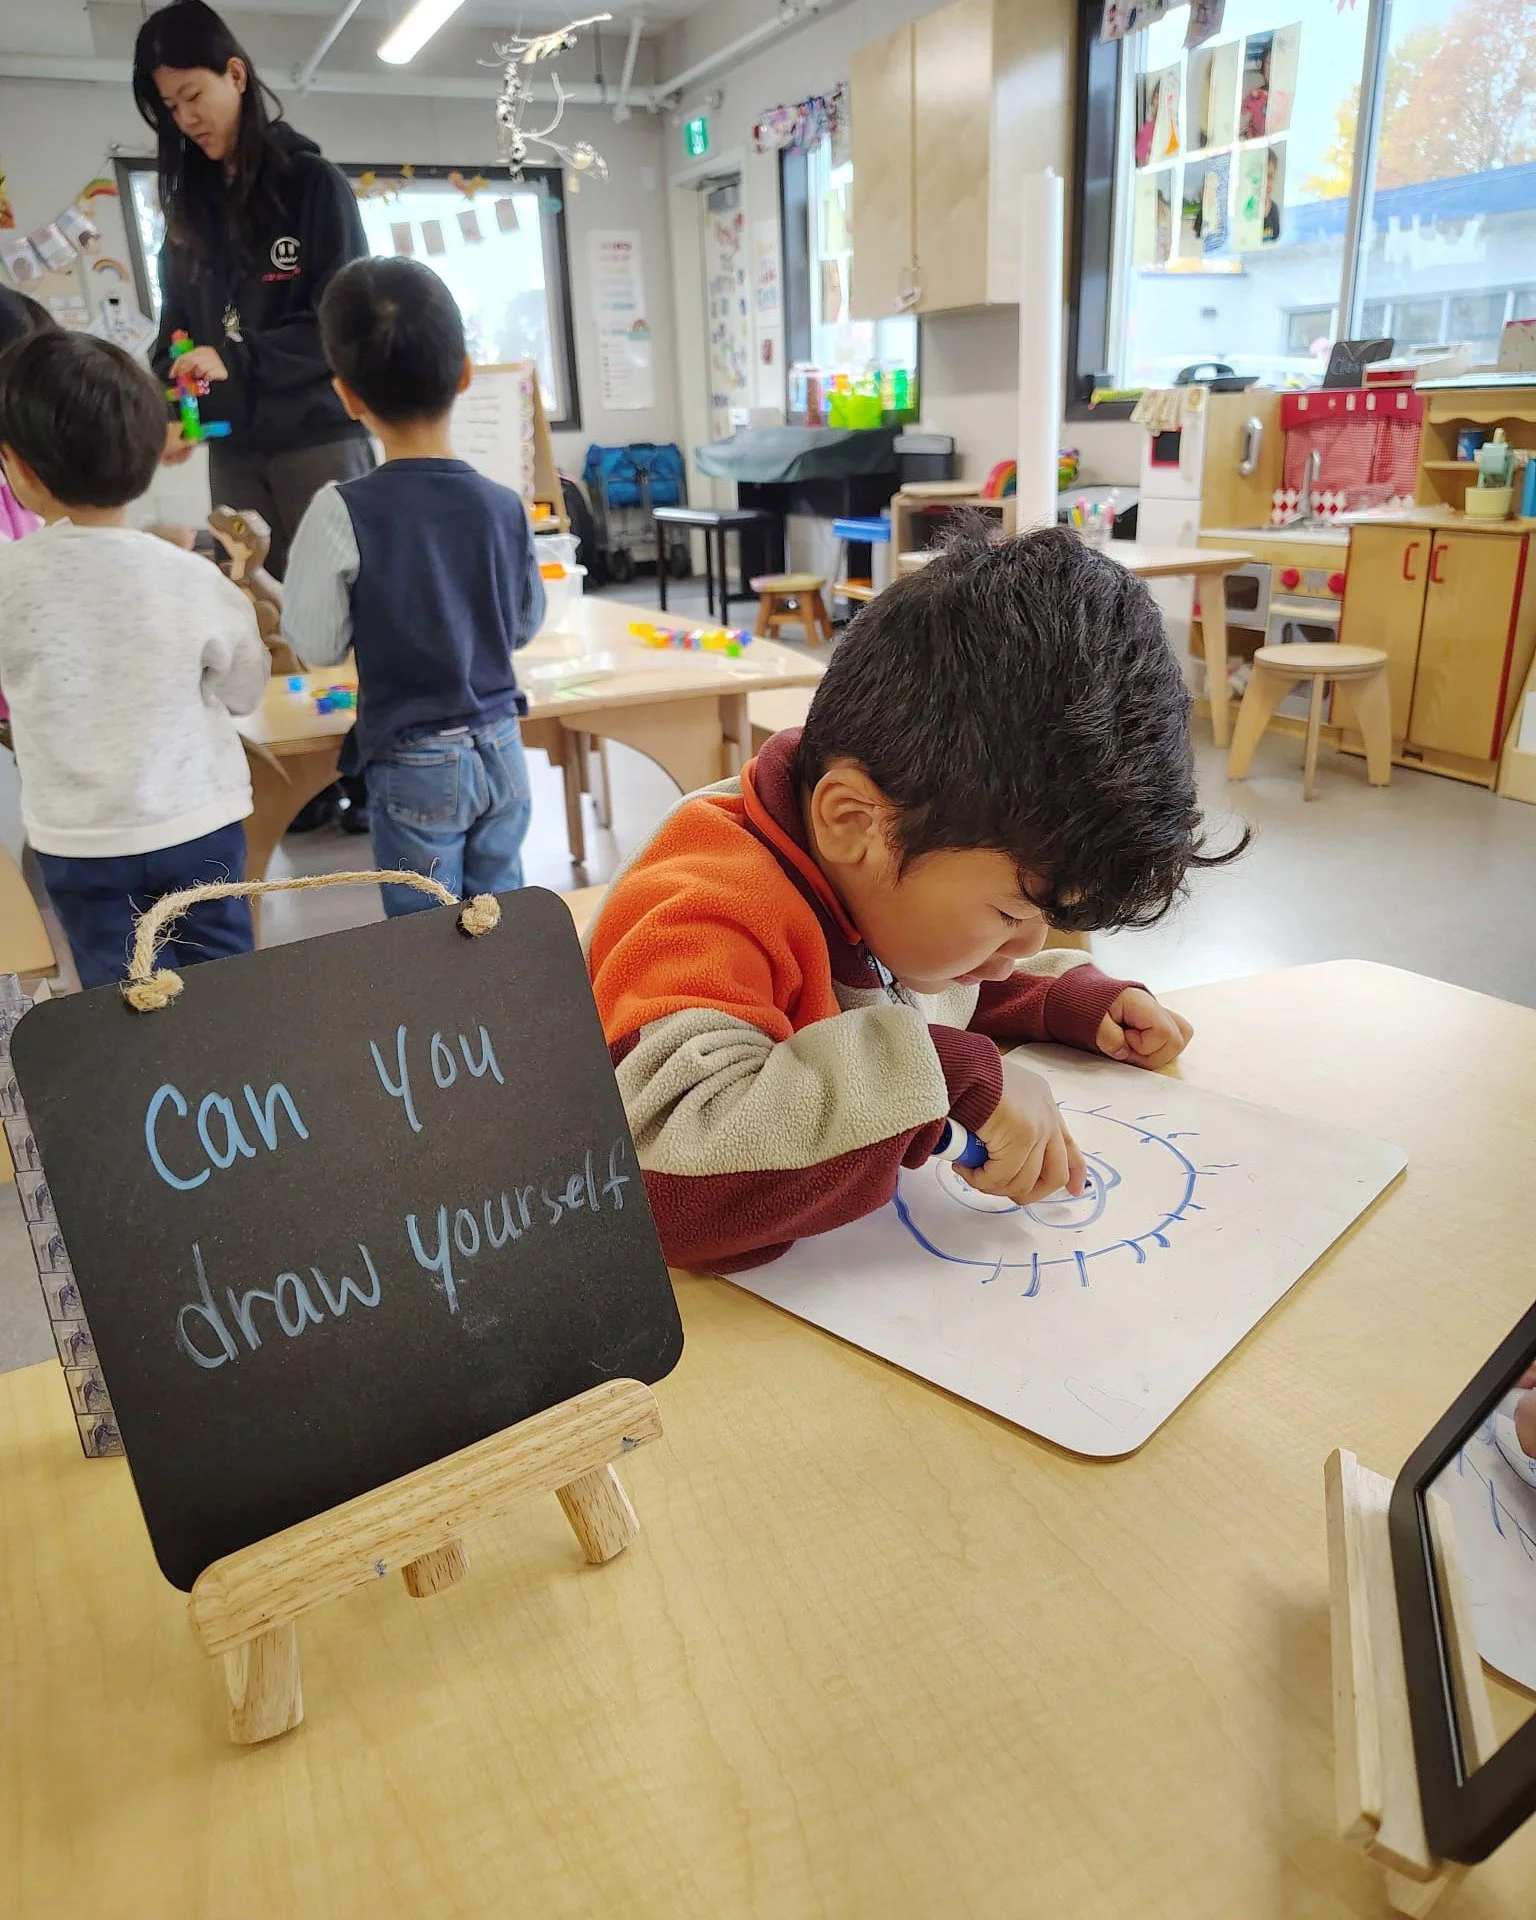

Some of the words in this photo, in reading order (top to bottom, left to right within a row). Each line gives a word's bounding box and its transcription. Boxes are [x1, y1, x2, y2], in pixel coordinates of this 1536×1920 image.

[145, 1083, 309, 1190] Can
[176, 1243, 381, 1368] draw
[405, 1136, 630, 1314] yourself
